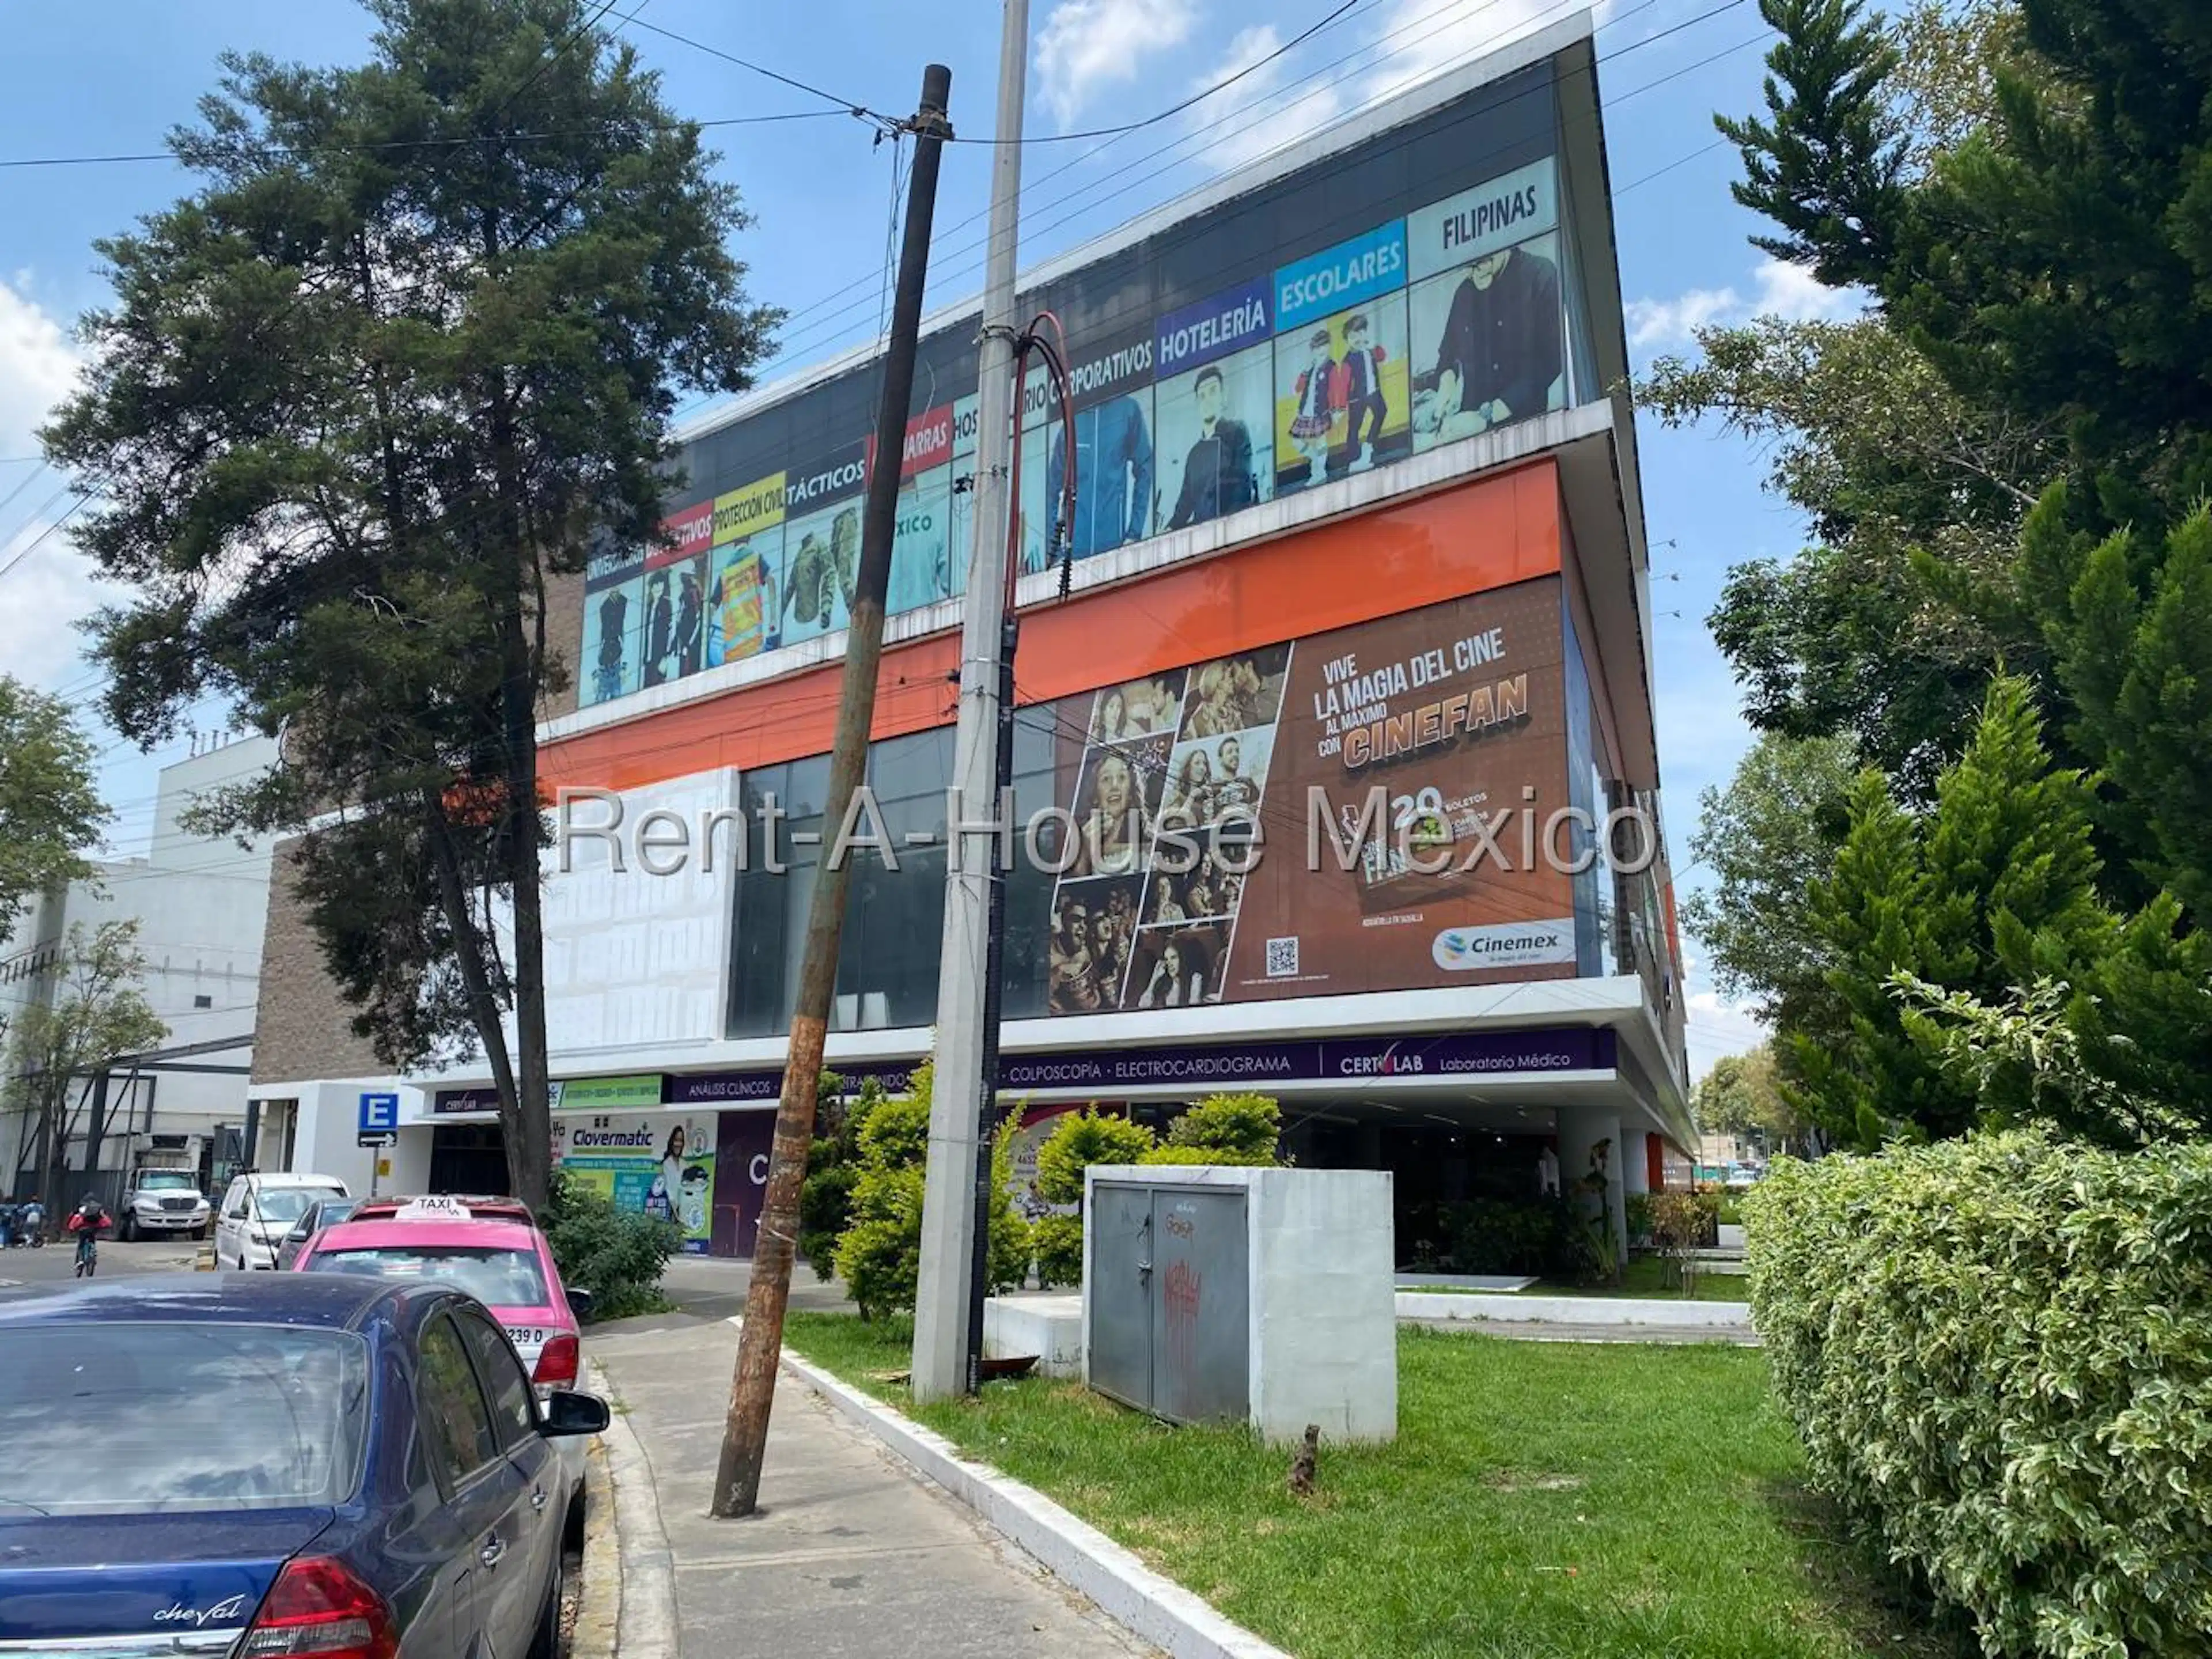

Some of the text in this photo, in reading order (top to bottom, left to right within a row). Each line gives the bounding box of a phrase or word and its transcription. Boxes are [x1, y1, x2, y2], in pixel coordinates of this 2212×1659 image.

[1442, 184, 1536, 249] FILIPINAS
[1281, 240, 1401, 313] ESCOLARES
[1160, 297, 1266, 365] HOTELERÍA
[786, 459, 865, 505] TÁCTICOS
[896, 516, 932, 537] XICO
[1314, 628, 1506, 721] LA MAGIA DEL CINE
[1323, 653, 1358, 685] VIVE
[1326, 718, 1341, 736] AL
[1343, 673, 1528, 768] CINEFAN
[1317, 736, 1341, 758] CON
[1472, 934, 1559, 953] Cinemex
[1010, 1056, 1291, 1083] COLPOSCOPÍA ELECTROCARDIOGRAMA
[1440, 1056, 1515, 1071] Laboratorio
[1517, 1053, 1571, 1069] Médico
[367, 1098, 390, 1126] E
[573, 1126, 654, 1147] Clovermatic
[419, 1199, 450, 1209] TAXI
[504, 1329, 530, 1343] 239
